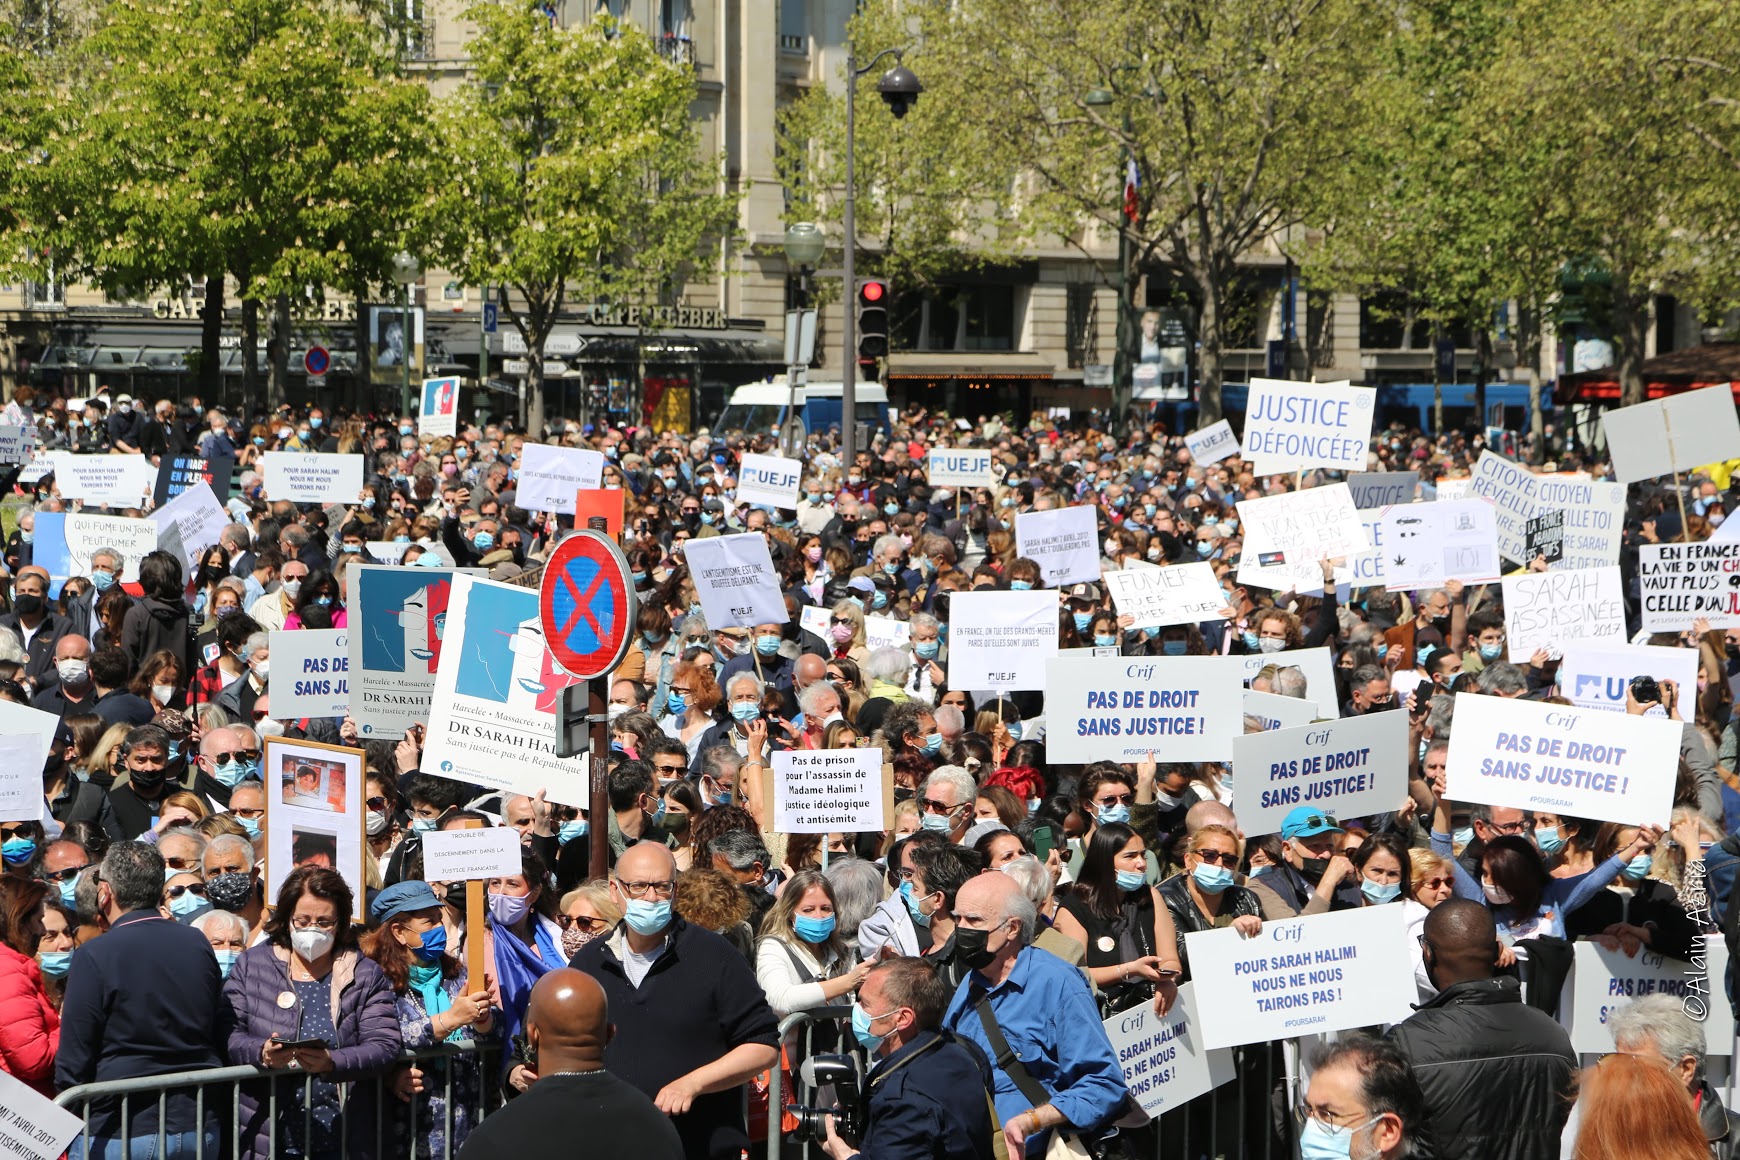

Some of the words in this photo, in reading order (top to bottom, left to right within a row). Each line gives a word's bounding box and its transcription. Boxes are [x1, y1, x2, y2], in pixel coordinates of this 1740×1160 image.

[1251, 394, 1350, 427] JUSTICE
[1202, 430, 1230, 448] UEJF
[1249, 427, 1363, 461] DÉFONCÉE?
[300, 467, 319, 475] SARAH
[947, 457, 990, 472] UEJF
[759, 470, 798, 488] UEJF
[1482, 457, 1537, 499] CITOYE
[315, 484, 326, 492] PAS
[1540, 482, 1592, 505] CITOYEN
[1262, 517, 1300, 536] NON
[1592, 511, 1612, 530] TOI
[82, 535, 105, 545] PEUT
[106, 538, 137, 548] FUMER
[1317, 526, 1341, 541] EN
[1577, 536, 1609, 551] SARAH
[1660, 547, 1681, 559] EN
[1687, 545, 1739, 559] FRANCE
[742, 565, 752, 575] EST
[751, 564, 763, 573] UNE
[1642, 563, 1661, 575] LA
[1663, 561, 1682, 573] VIE
[1513, 571, 1599, 609] SARAH
[1643, 576, 1678, 590] VAUT
[1682, 575, 1720, 590] PLUS
[737, 606, 753, 615] UEJF
[1181, 601, 1222, 614] TUER
[1646, 595, 1691, 612] CELLE
[956, 627, 963, 636] EN
[985, 627, 992, 636] ON
[993, 627, 1002, 636] TUE
[1003, 627, 1014, 636] DES
[1592, 623, 1621, 637] 2017
[968, 639, 983, 648] PARCE
[1007, 639, 1020, 648] SONT
[1021, 639, 1040, 647] JUIVES
[303, 658, 329, 674] PAS
[1126, 664, 1156, 681] Crif
[363, 677, 391, 686] Harcelée
[397, 680, 431, 688] Massacrée
[995, 672, 1017, 681] UEJF
[294, 680, 331, 697] SANS
[1086, 691, 1119, 709] PAS
[1122, 691, 1145, 709] DE
[1149, 690, 1199, 708] DROIT
[363, 706, 381, 714] Sans
[382, 707, 406, 716] justice
[407, 709, 421, 717] pas
[452, 702, 487, 717] Harcelée
[494, 711, 536, 727] Massacrée
[1077, 717, 1121, 736] SANS
[1125, 717, 1195, 735] JUSTICE
[1199, 717, 1205, 735] !
[1545, 711, 1579, 732] Crif
[1305, 728, 1333, 747] Crif
[445, 737, 468, 749] Sans
[468, 741, 500, 756] justice
[500, 750, 518, 760] pas
[518, 750, 530, 763] de
[531, 754, 582, 775] République
[1496, 733, 1531, 754] PAS
[1536, 737, 1561, 757] DE
[1566, 741, 1626, 766] DROIT
[792, 756, 807, 766] Pas
[810, 756, 823, 765] de
[825, 756, 855, 767] prison
[1270, 760, 1298, 781] PAS
[1302, 756, 1322, 776] DE
[1325, 748, 1370, 774] DROIT
[786, 772, 802, 782] pour
[806, 769, 852, 780] l'assassin
[855, 769, 867, 778] de
[1480, 757, 1531, 782] SANS
[1535, 765, 1617, 794] JUSTICE
[1621, 777, 1629, 795] !
[788, 784, 824, 795] Madame
[827, 783, 857, 794] Halimi
[1261, 787, 1301, 808] SANS
[1304, 774, 1366, 802] JUSTICE
[1369, 773, 1375, 789] !
[785, 800, 811, 810] justice
[813, 799, 870, 810] idéologique
[1529, 796, 1573, 808] #POURSARAH
[796, 815, 804, 824] et
[806, 814, 857, 824] antisémite
[1272, 923, 1304, 943] Crif
[1234, 957, 1267, 976] POUR
[1271, 952, 1312, 971] SARAH
[1314, 945, 1357, 966] HALIMI
[1252, 976, 1286, 994] NOUS
[1289, 974, 1306, 990] NE
[1309, 967, 1343, 986] NOUS
[1609, 978, 1634, 996] PAS
[1257, 994, 1309, 1013] TAIRONS
[1312, 991, 1335, 1006] PAS
[1337, 988, 1342, 1001] !
[1121, 1010, 1146, 1034] Crif
[1284, 1015, 1327, 1028] #POURSARAH
[1120, 1037, 1152, 1063] SARAH
[1154, 1021, 1187, 1048] HALIMI
[1134, 1060, 1148, 1077] NE
[1149, 1046, 1176, 1069] NOUS
[1152, 1069, 1171, 1088] PAS
[7, 1111, 17, 1122] 7
[12, 1116, 37, 1137] AVRIL
